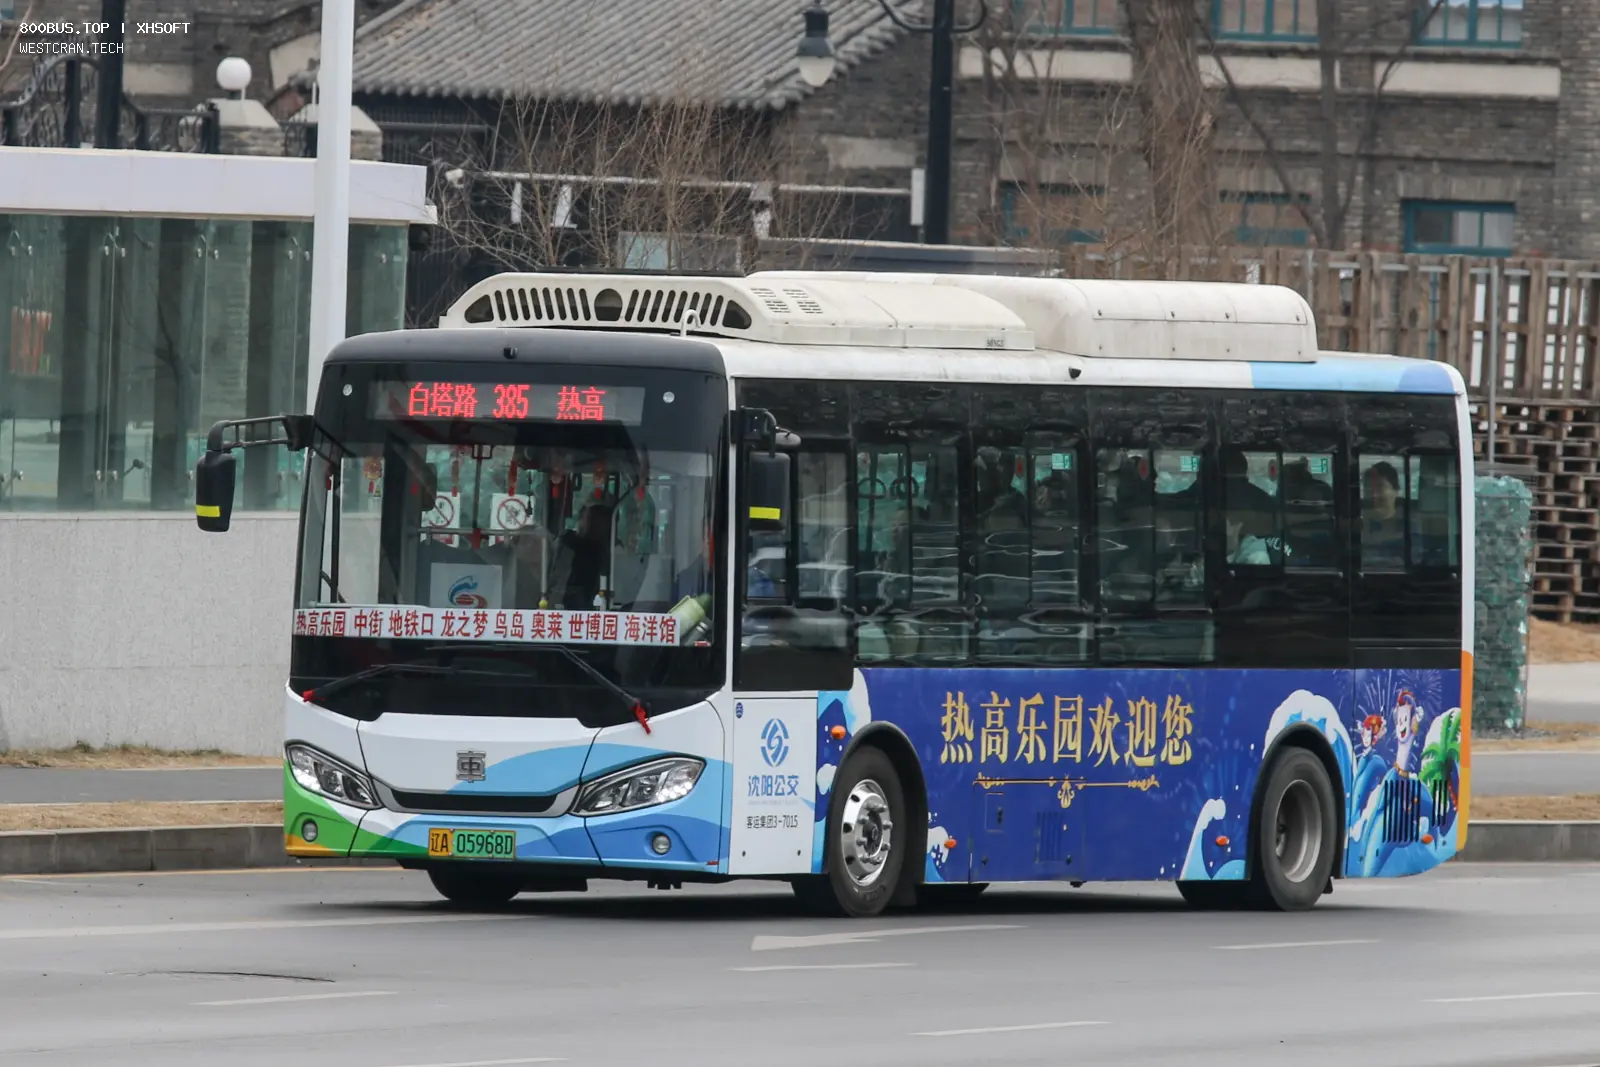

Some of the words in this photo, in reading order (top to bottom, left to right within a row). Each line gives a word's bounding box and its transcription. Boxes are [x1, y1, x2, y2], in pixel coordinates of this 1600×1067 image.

[408, 382, 478, 418] 白塔路
[492, 384, 530, 418] 385
[556, 386, 606, 420] 热高
[296, 610, 347, 637] 热高乐园
[354, 609, 384, 637] 中街
[388, 609, 434, 637] 地铁口
[441, 611, 489, 639] 龙之梦
[494, 611, 524, 639] 鸟岛
[531, 611, 563, 639] 奥莱
[568, 613, 618, 641] 世博园
[624, 615, 676, 643] 海洋馆
[940, 691, 1194, 768] 热高乐园欢迎您
[748, 775, 799, 797] 沈阳公交
[746, 814, 799, 829] 客运集团3-7015
